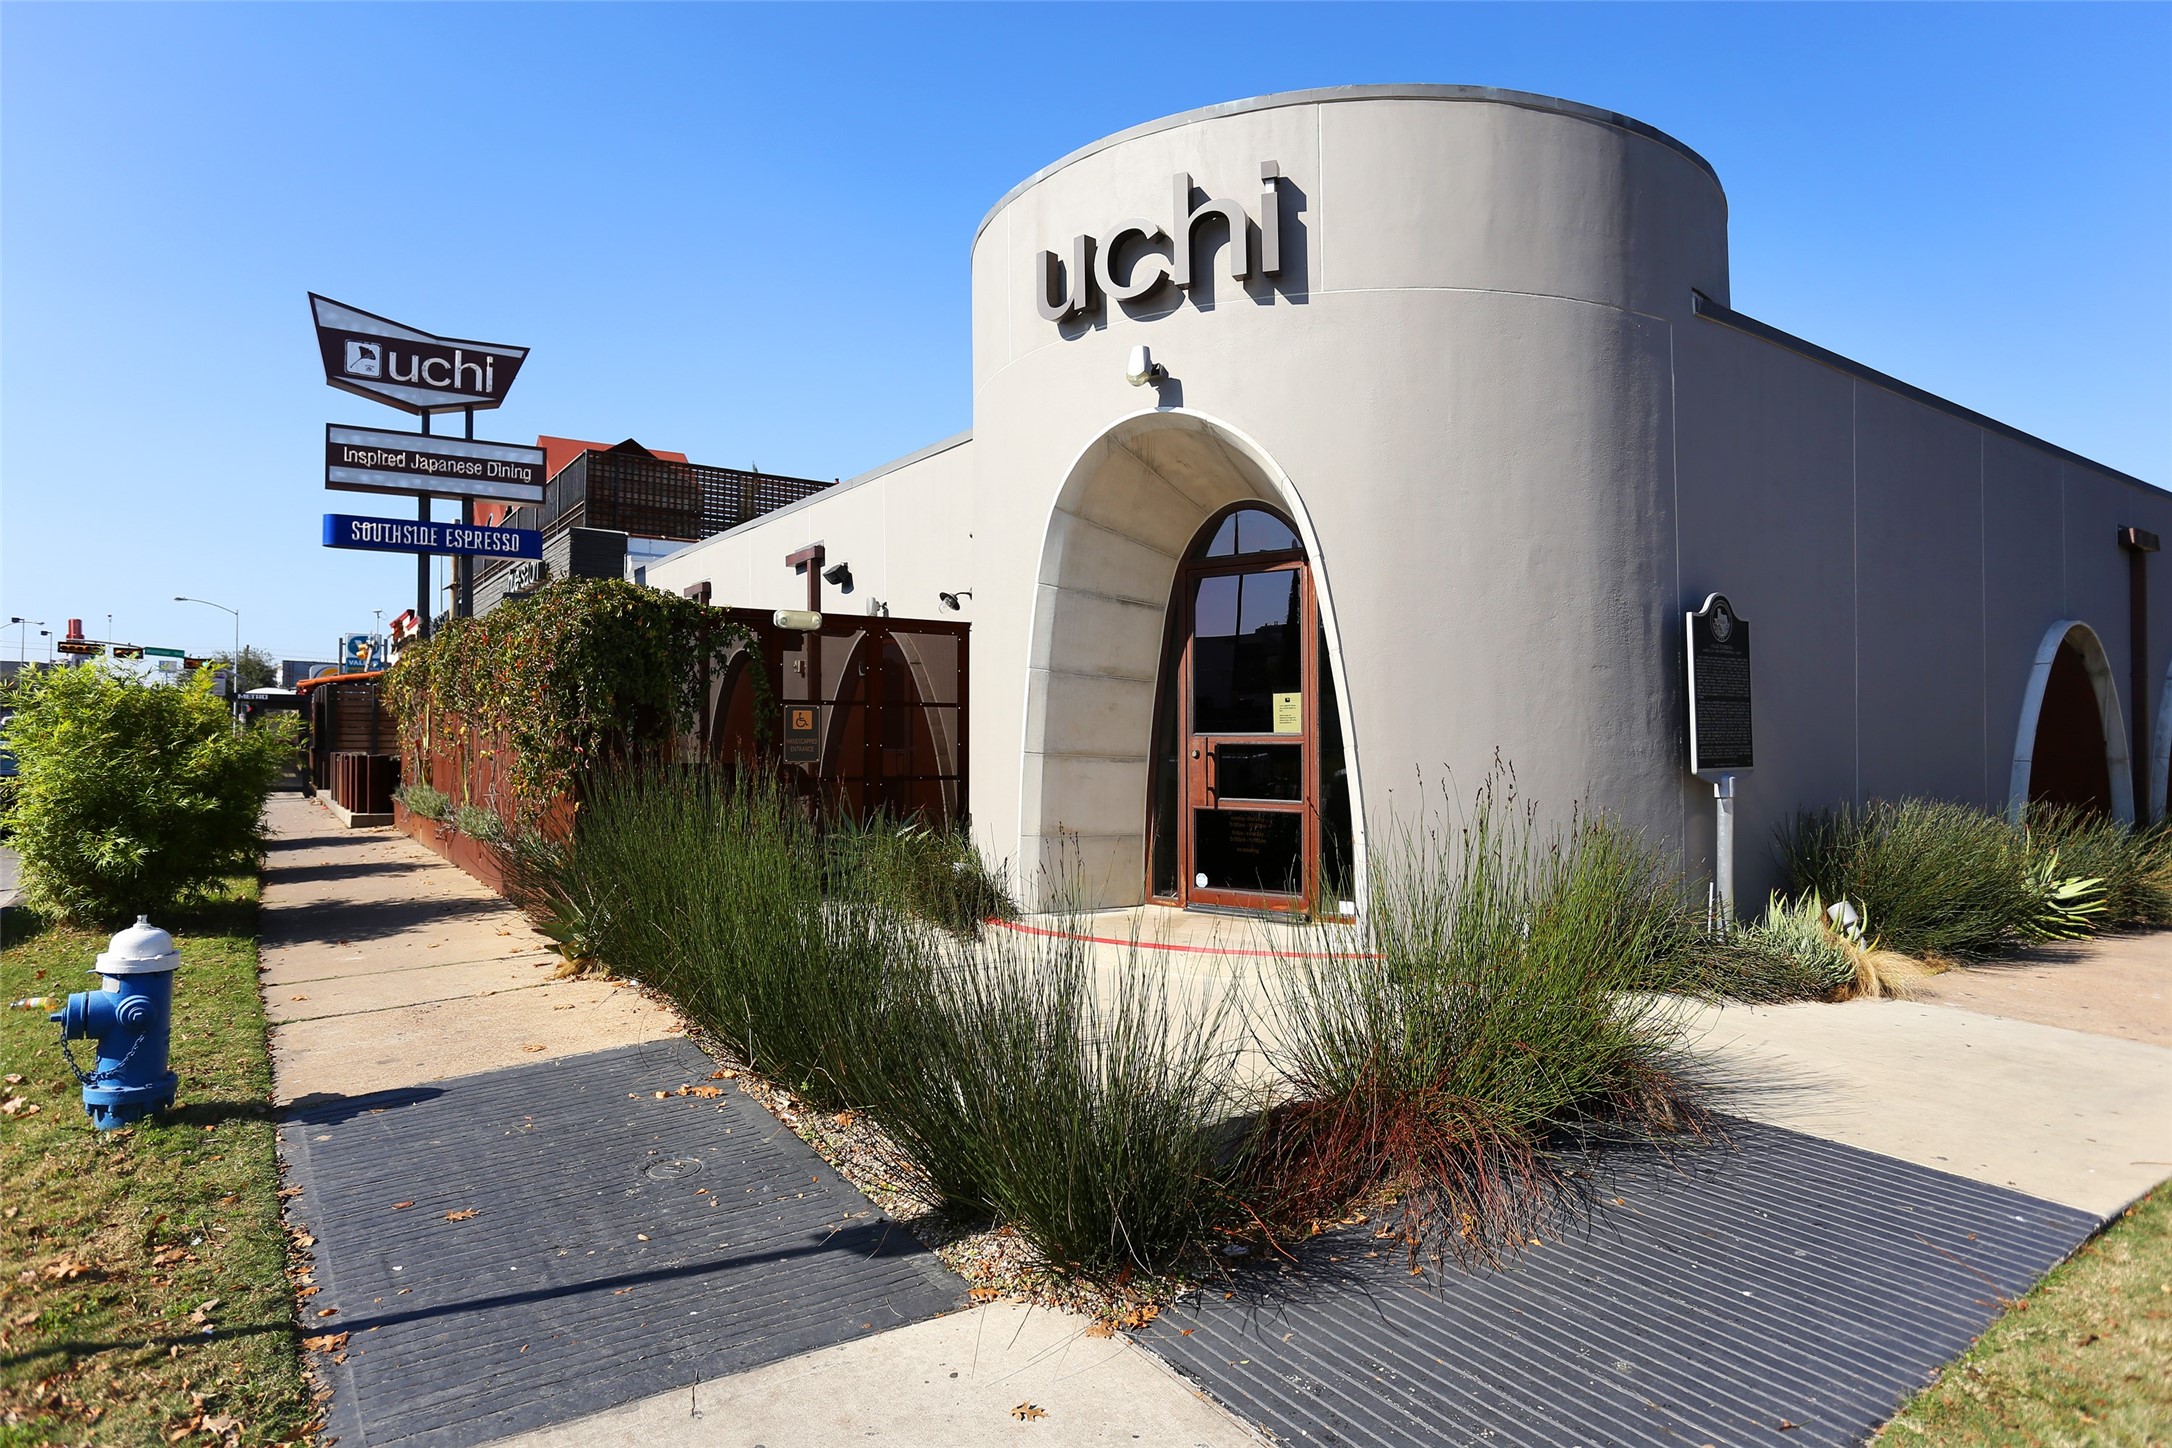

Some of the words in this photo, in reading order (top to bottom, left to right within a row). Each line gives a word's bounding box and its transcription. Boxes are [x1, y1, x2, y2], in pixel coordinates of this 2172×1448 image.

[1036, 160, 1281, 324] uchi
[389, 350, 494, 393] uchi
[344, 446, 406, 467] Inspired
[411, 453, 482, 475] Japanese
[487, 461, 532, 483] Dining
[446, 528, 520, 552] ESPRESSO
